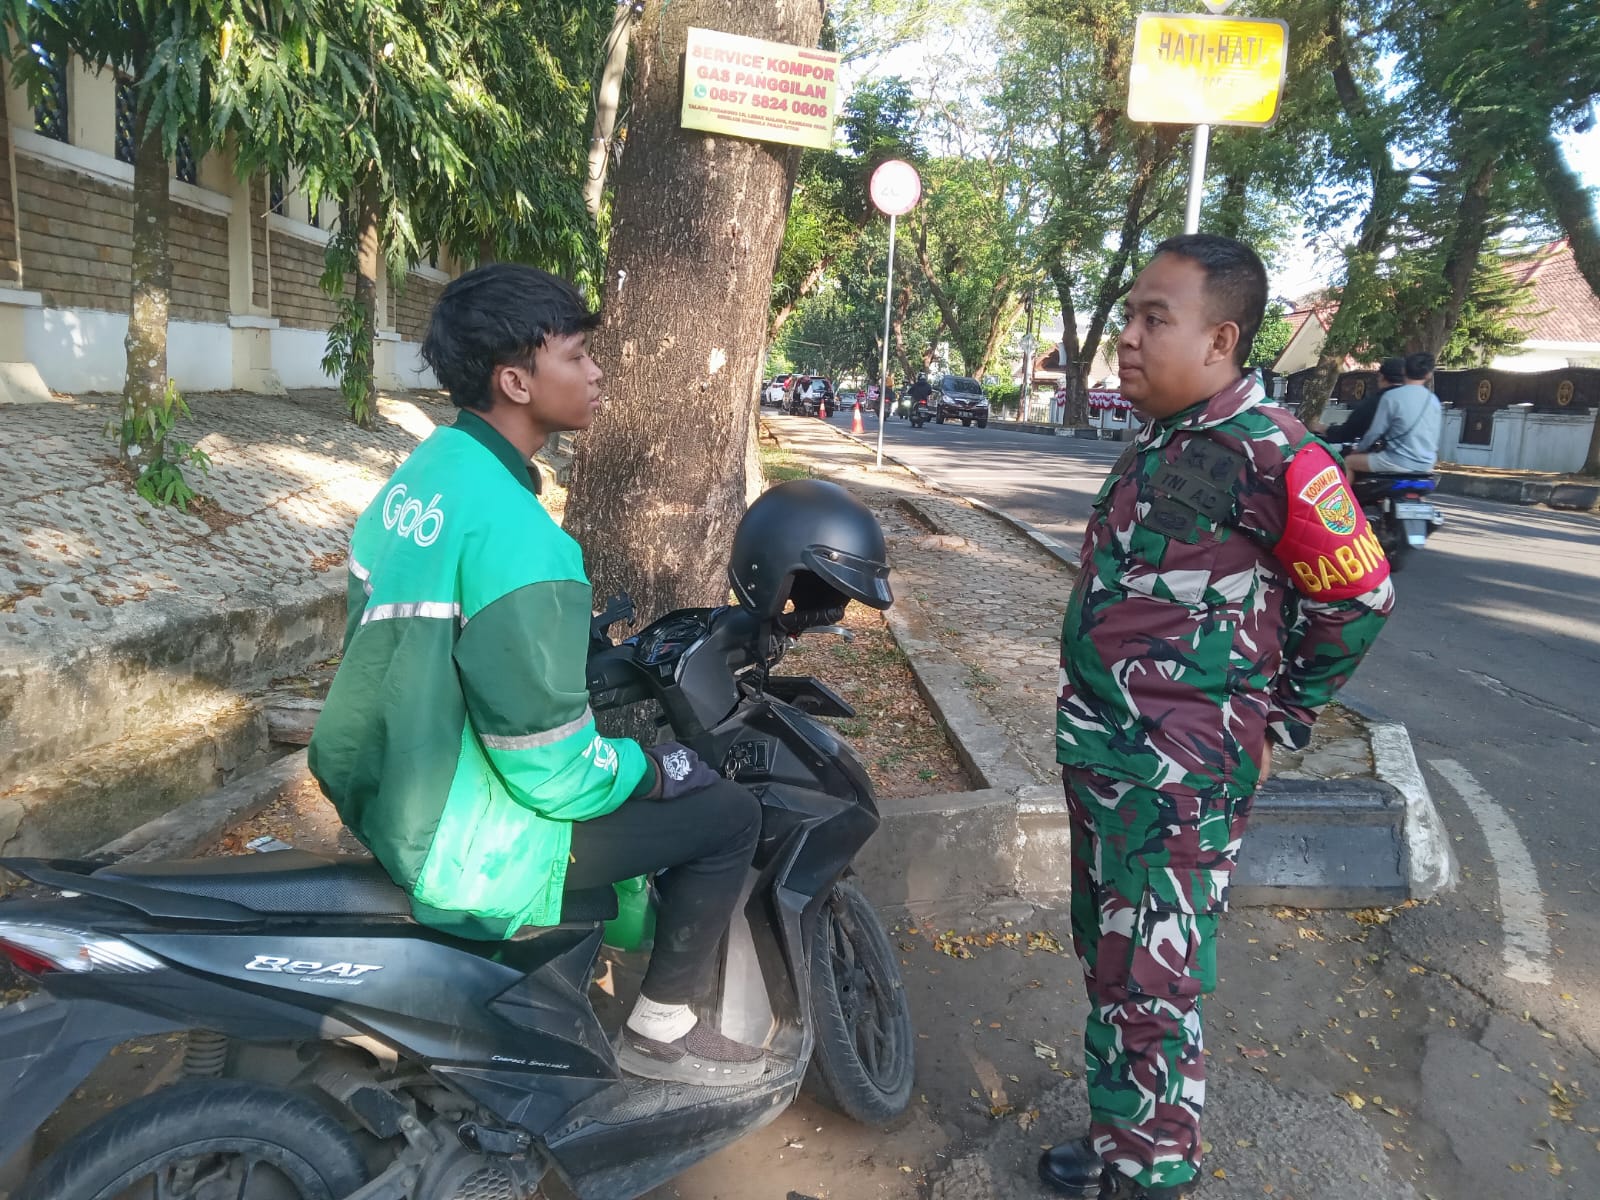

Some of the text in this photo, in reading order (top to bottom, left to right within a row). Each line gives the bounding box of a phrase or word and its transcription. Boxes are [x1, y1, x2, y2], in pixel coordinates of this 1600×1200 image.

[692, 46, 762, 68] SERVICE
[767, 57, 834, 81] KOMPOR
[1160, 32, 1263, 64] HATI-HATI
[697, 65, 827, 99] GAS PANGGILAN
[709, 86, 748, 104] 0857
[752, 94, 788, 111] 5824
[1162, 473, 1188, 491] TNI
[1293, 520, 1385, 592] BABIN
